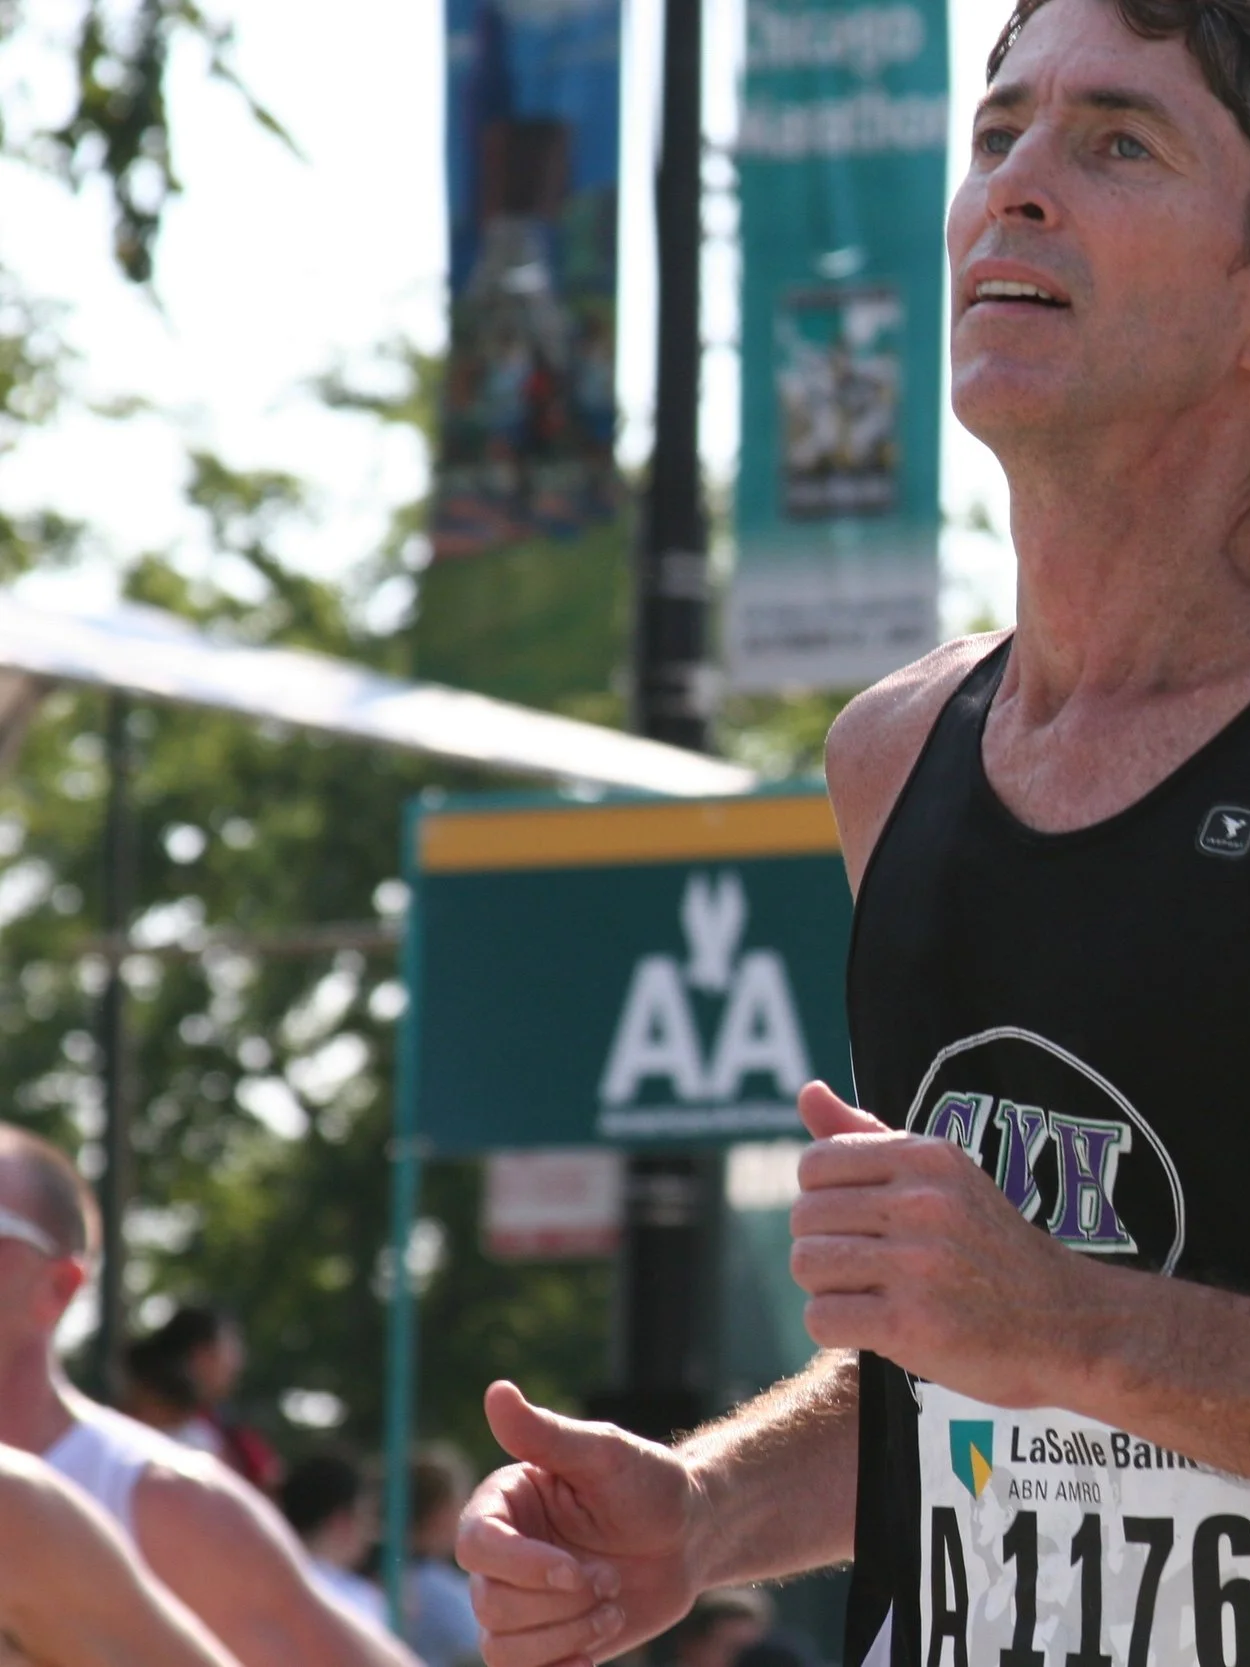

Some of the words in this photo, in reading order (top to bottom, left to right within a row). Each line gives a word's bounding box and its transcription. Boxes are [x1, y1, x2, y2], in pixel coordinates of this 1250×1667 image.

[1010, 1425, 1107, 1468] LaSalle
[1008, 1478, 1047, 1501] ABN
[1055, 1480, 1102, 1504] AMRO
